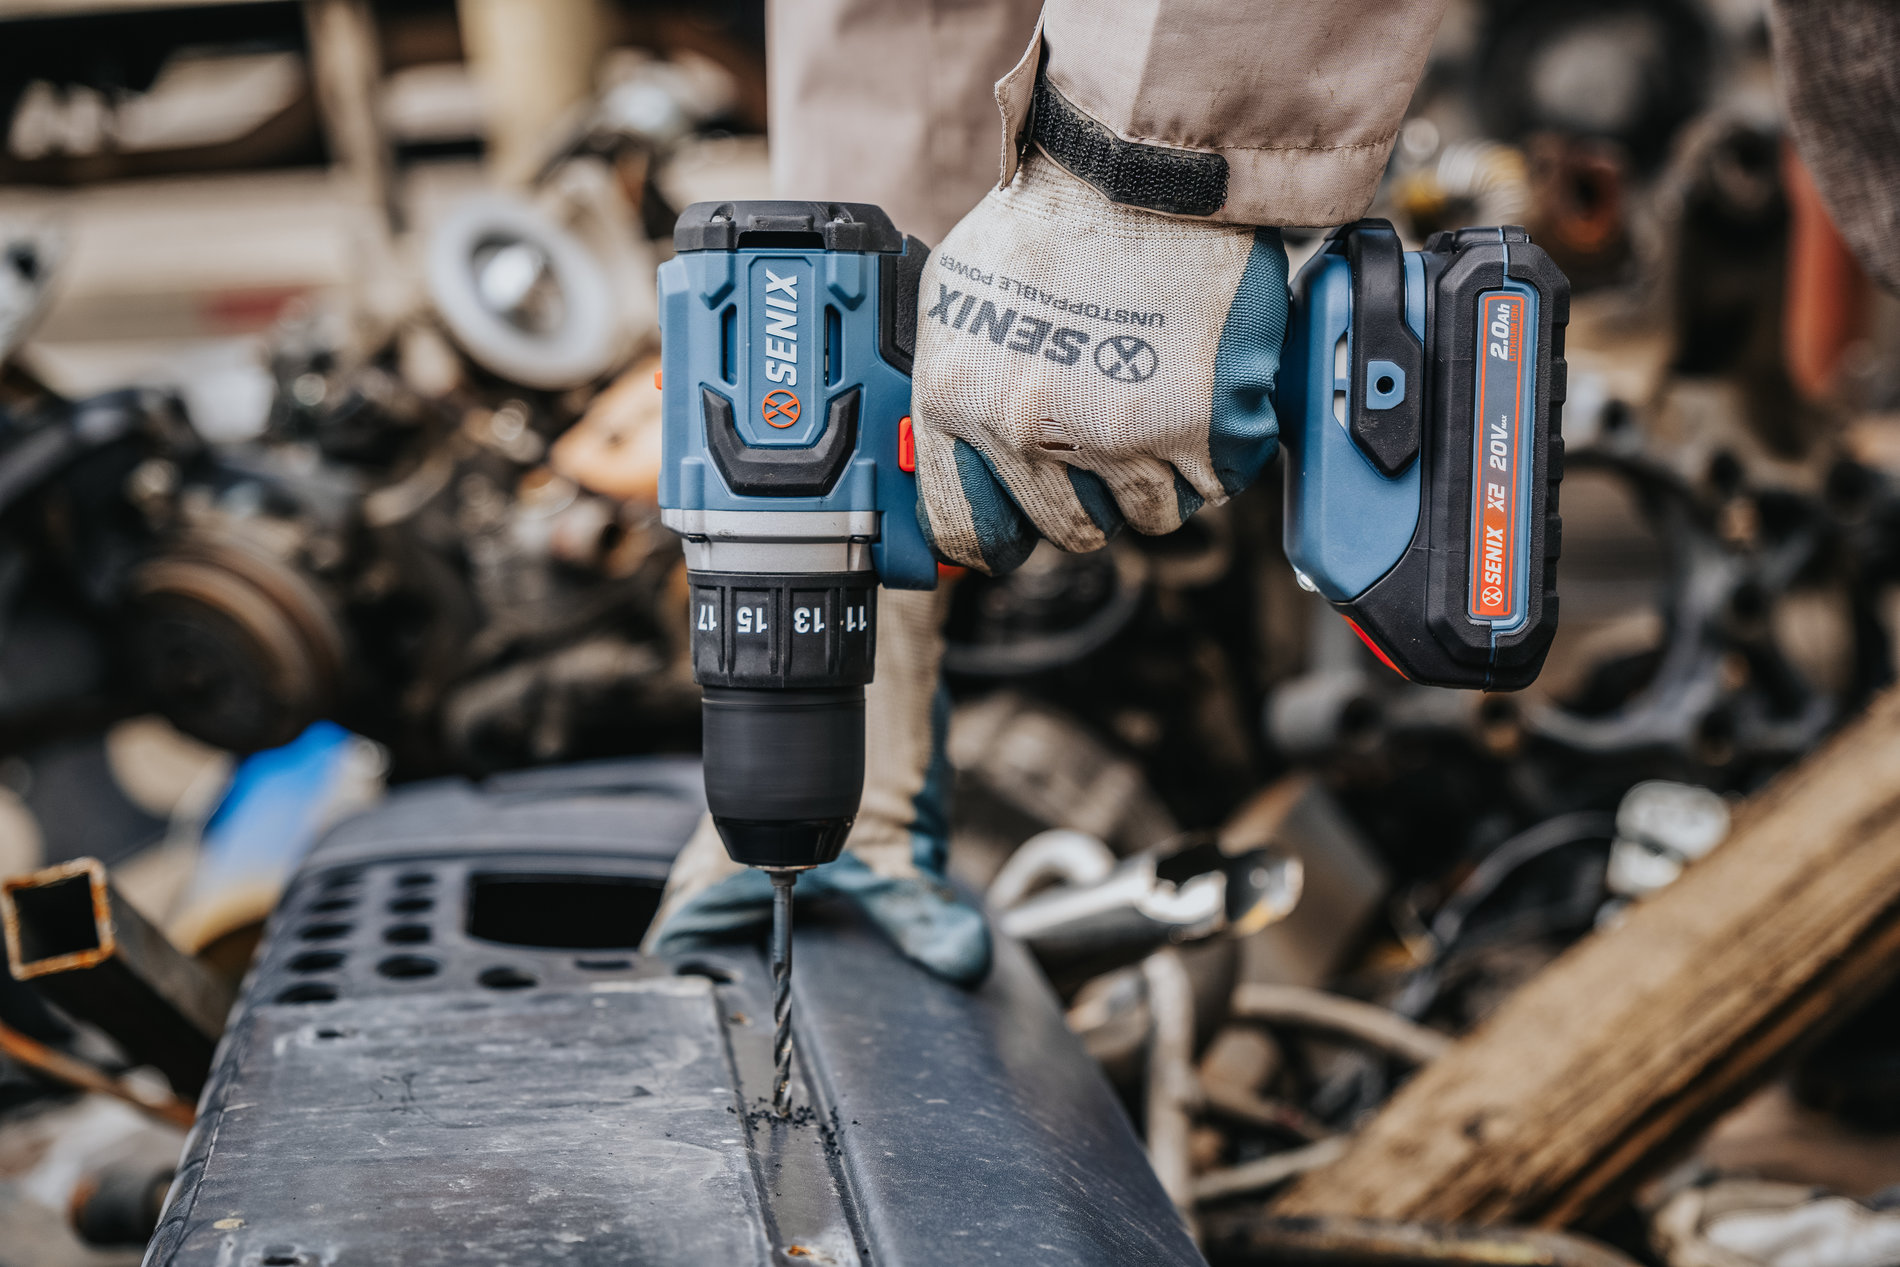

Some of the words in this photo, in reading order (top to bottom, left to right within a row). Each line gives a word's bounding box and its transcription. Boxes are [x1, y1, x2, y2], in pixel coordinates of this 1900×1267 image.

[940, 253, 994, 287] POWER
[998, 276, 1165, 327] UNSTOPPABLE
[1511, 304, 1520, 321] ION
[765, 268, 798, 387] SENIX
[928, 284, 1090, 366] SENIX
[1490, 303, 1511, 361] 2.0Ah
[1509, 323, 1519, 362] LITHIUM
[1487, 483, 1505, 512] X2
[1484, 525, 1504, 586] SENIX
[697, 605, 718, 632] 17
[736, 606, 768, 634] 15
[793, 607, 825, 634] 13
[846, 605, 867, 632] 11
